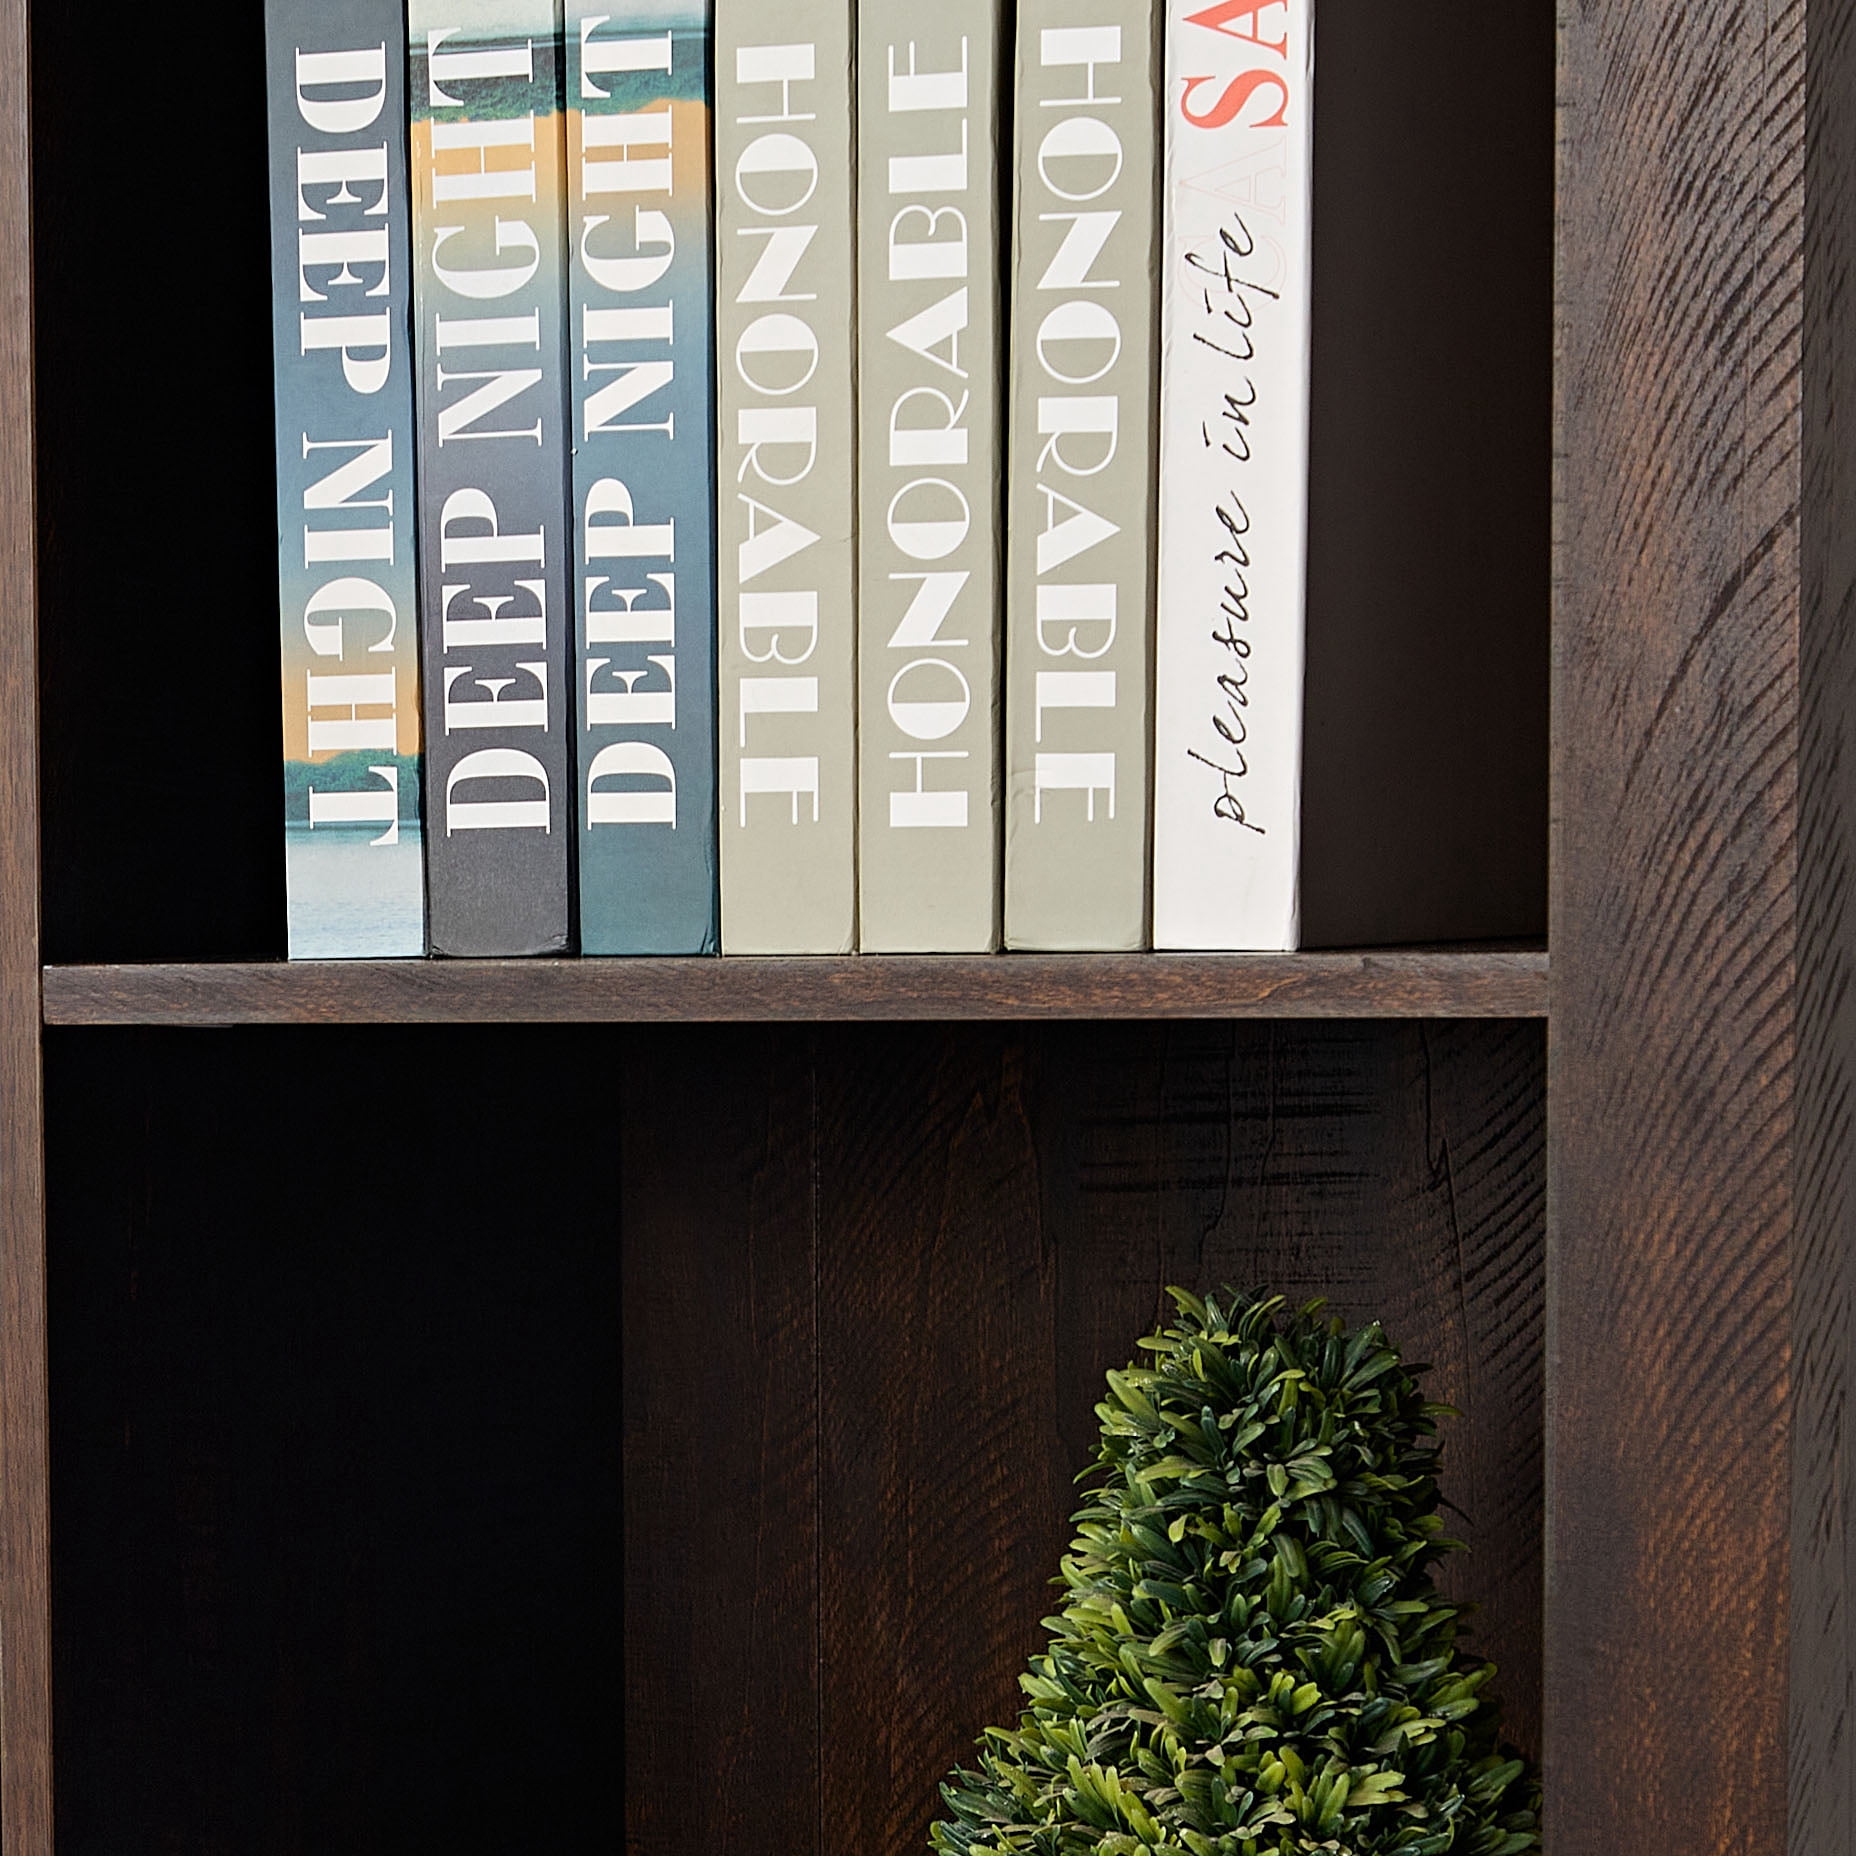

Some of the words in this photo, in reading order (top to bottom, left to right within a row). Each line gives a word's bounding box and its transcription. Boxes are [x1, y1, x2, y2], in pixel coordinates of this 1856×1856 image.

[293, 40, 392, 395] DEEP
[426, 25, 544, 447] NIGHT
[580, 13, 677, 443] NIGHT
[1183, 210, 1281, 361] life
[735, 42, 821, 829] HONORABLE
[885, 36, 971, 830] HONORABLE
[1034, 24, 1124, 824] HONORABLE
[1202, 375, 1256, 461] in
[301, 428, 400, 847] NIGHT
[439, 487, 552, 838] DEEP
[586, 477, 678, 831] DEEP
[1187, 489, 1266, 835] pleasure
